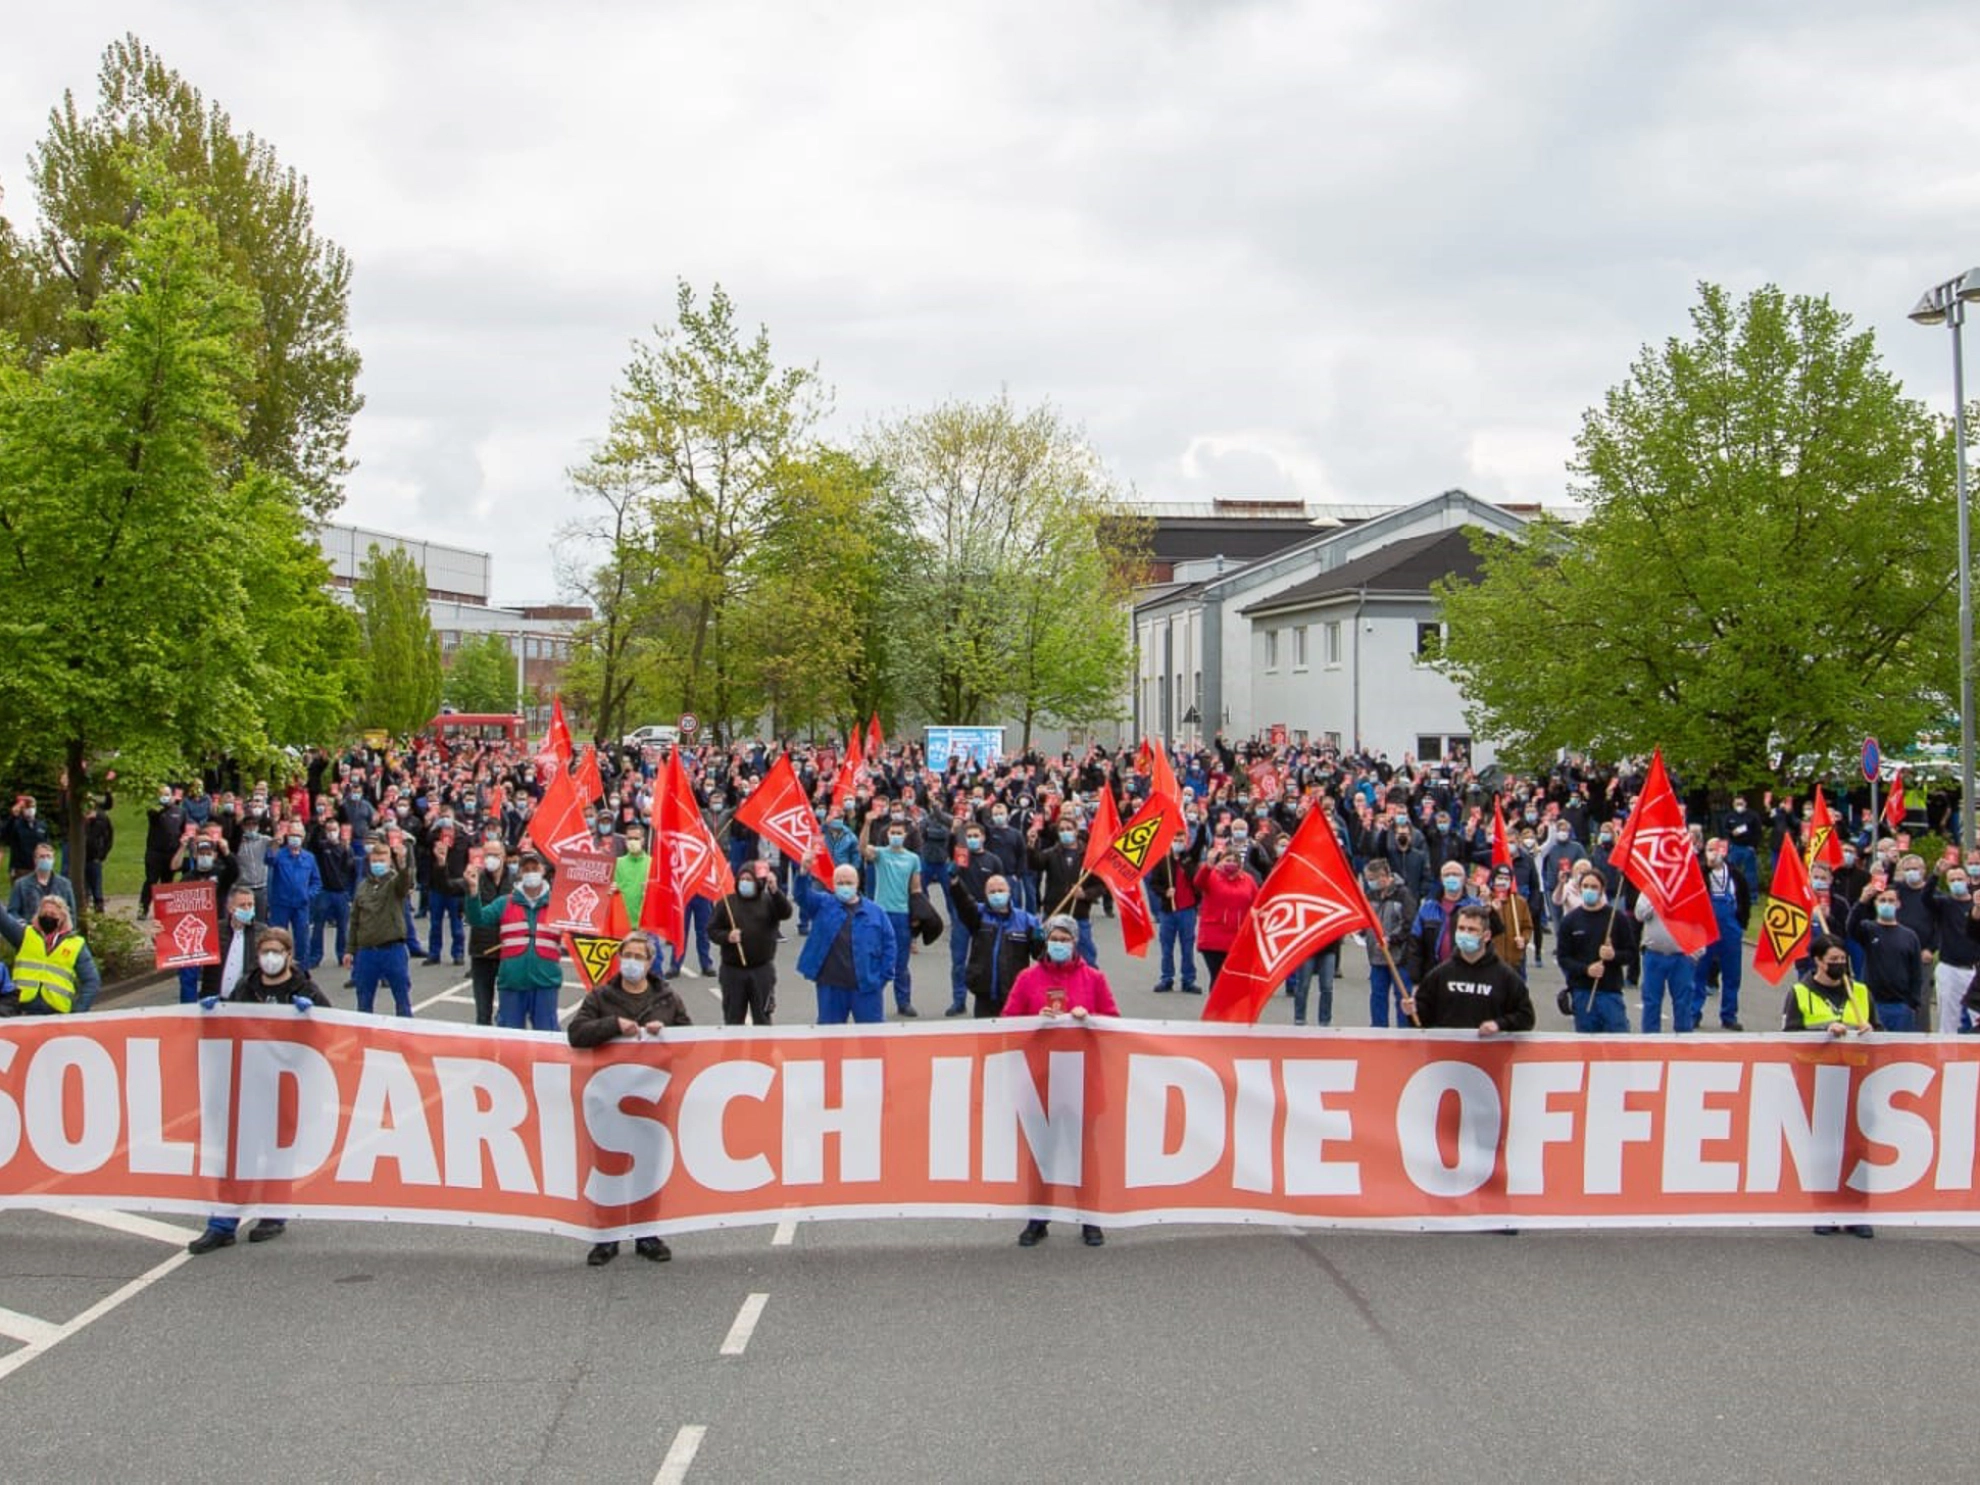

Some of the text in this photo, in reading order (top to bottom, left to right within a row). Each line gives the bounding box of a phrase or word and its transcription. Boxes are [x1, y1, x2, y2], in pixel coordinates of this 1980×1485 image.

[0, 1036, 1980, 1206] OLIDARISCH IN DIE OFFENSI
